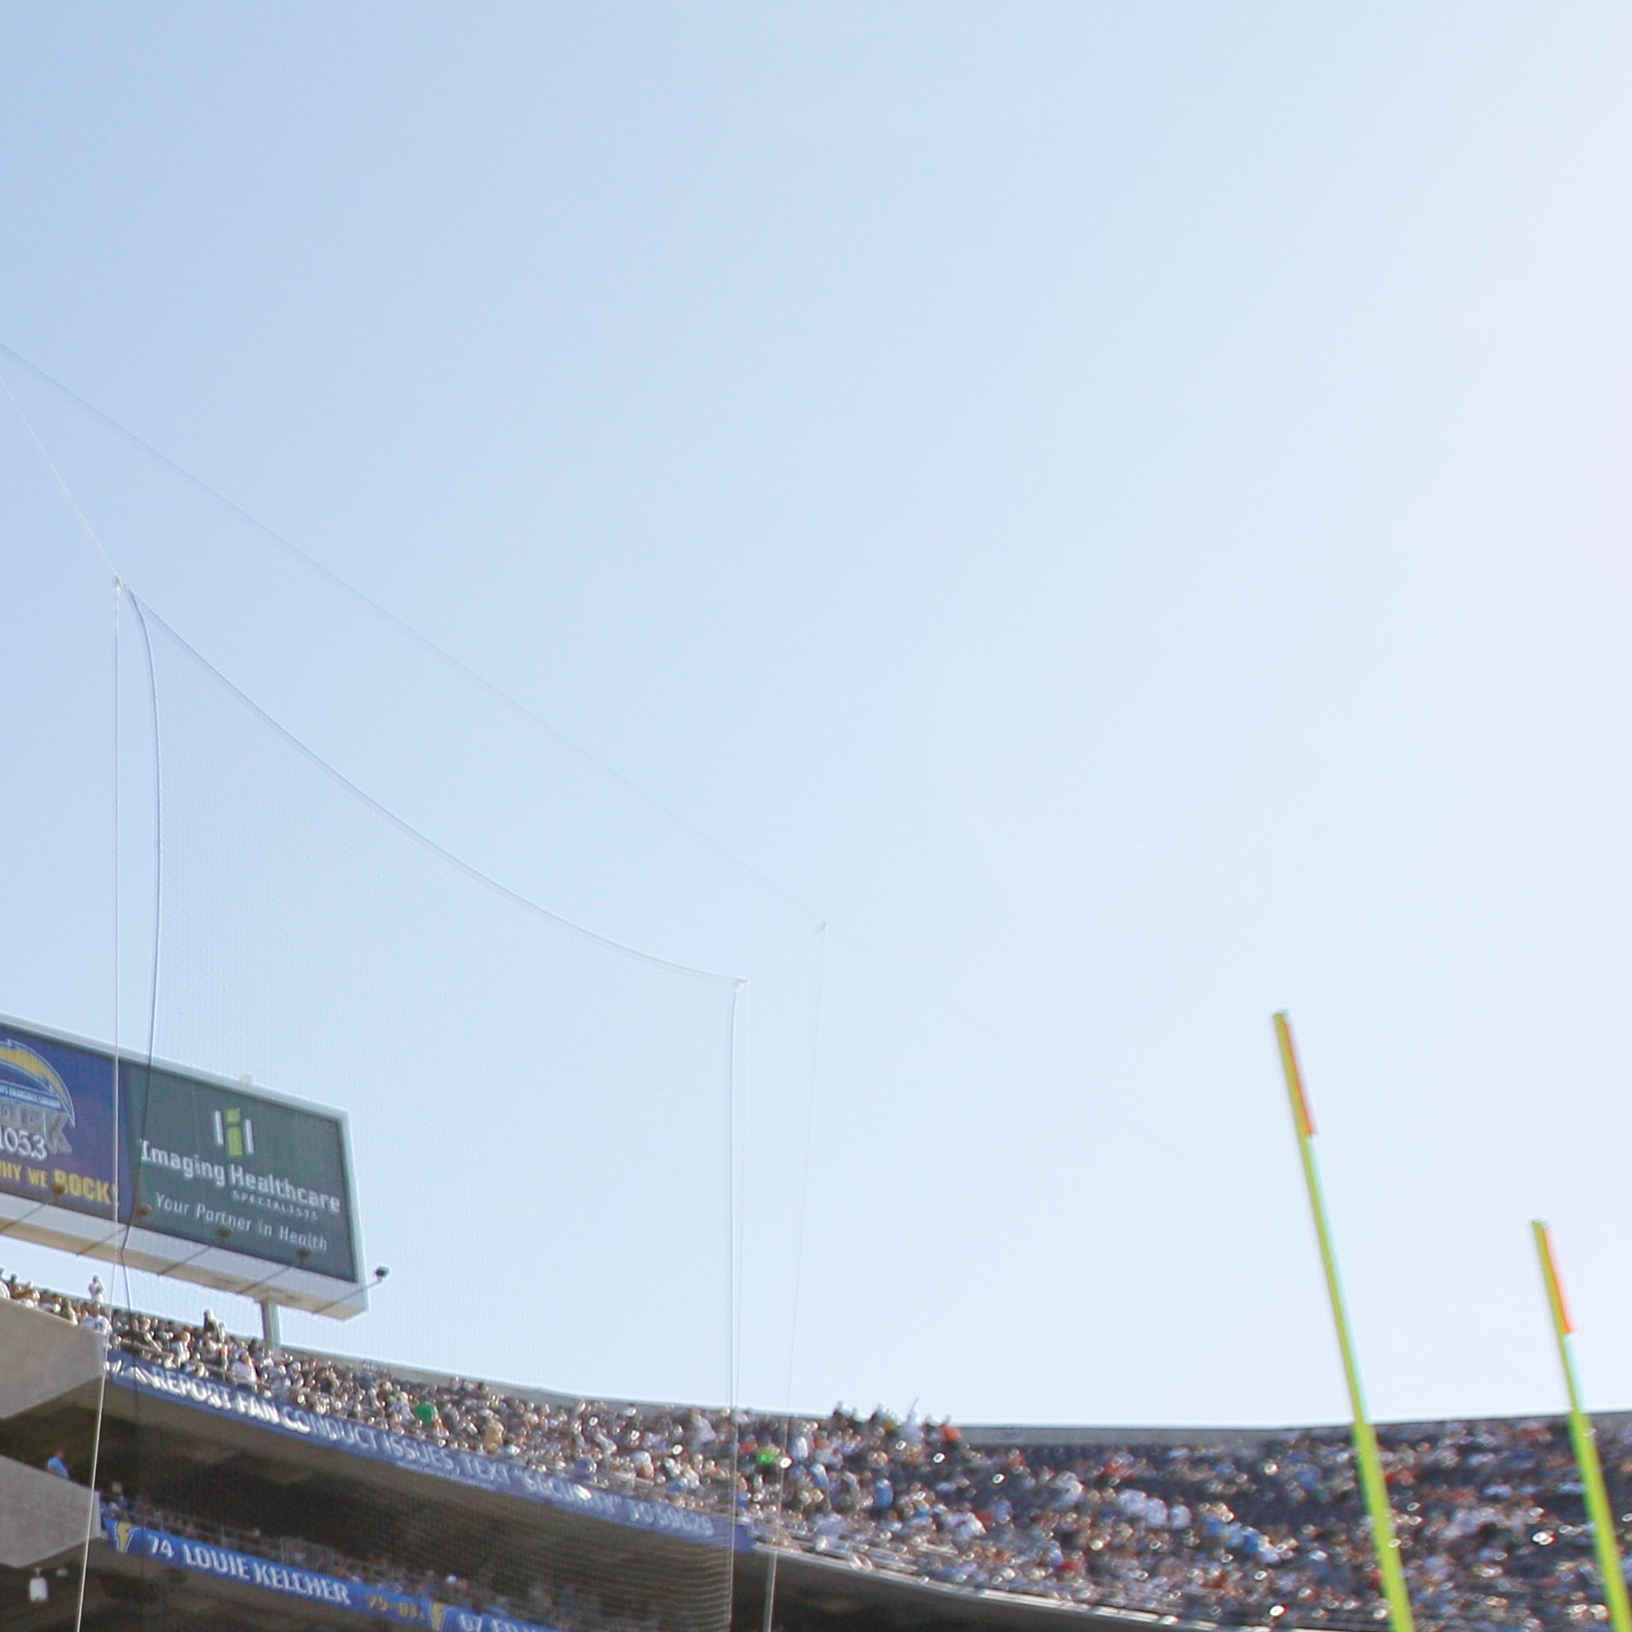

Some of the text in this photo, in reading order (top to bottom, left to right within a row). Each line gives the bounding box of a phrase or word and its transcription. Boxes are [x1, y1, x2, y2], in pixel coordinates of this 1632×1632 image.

[28, 1167, 49, 1188] WE
[141, 1139, 342, 1214] Imaging Healthcare
[155, 1192, 329, 1252] Your Partner in Health
[151, 1368, 233, 1410] REPORT
[236, 1394, 280, 1424] FAN
[282, 1405, 379, 1450] CONDUCT
[147, 1533, 175, 1560] 74
[182, 1543, 251, 1580] LOUIE
[253, 1561, 353, 1606] KELCHER
